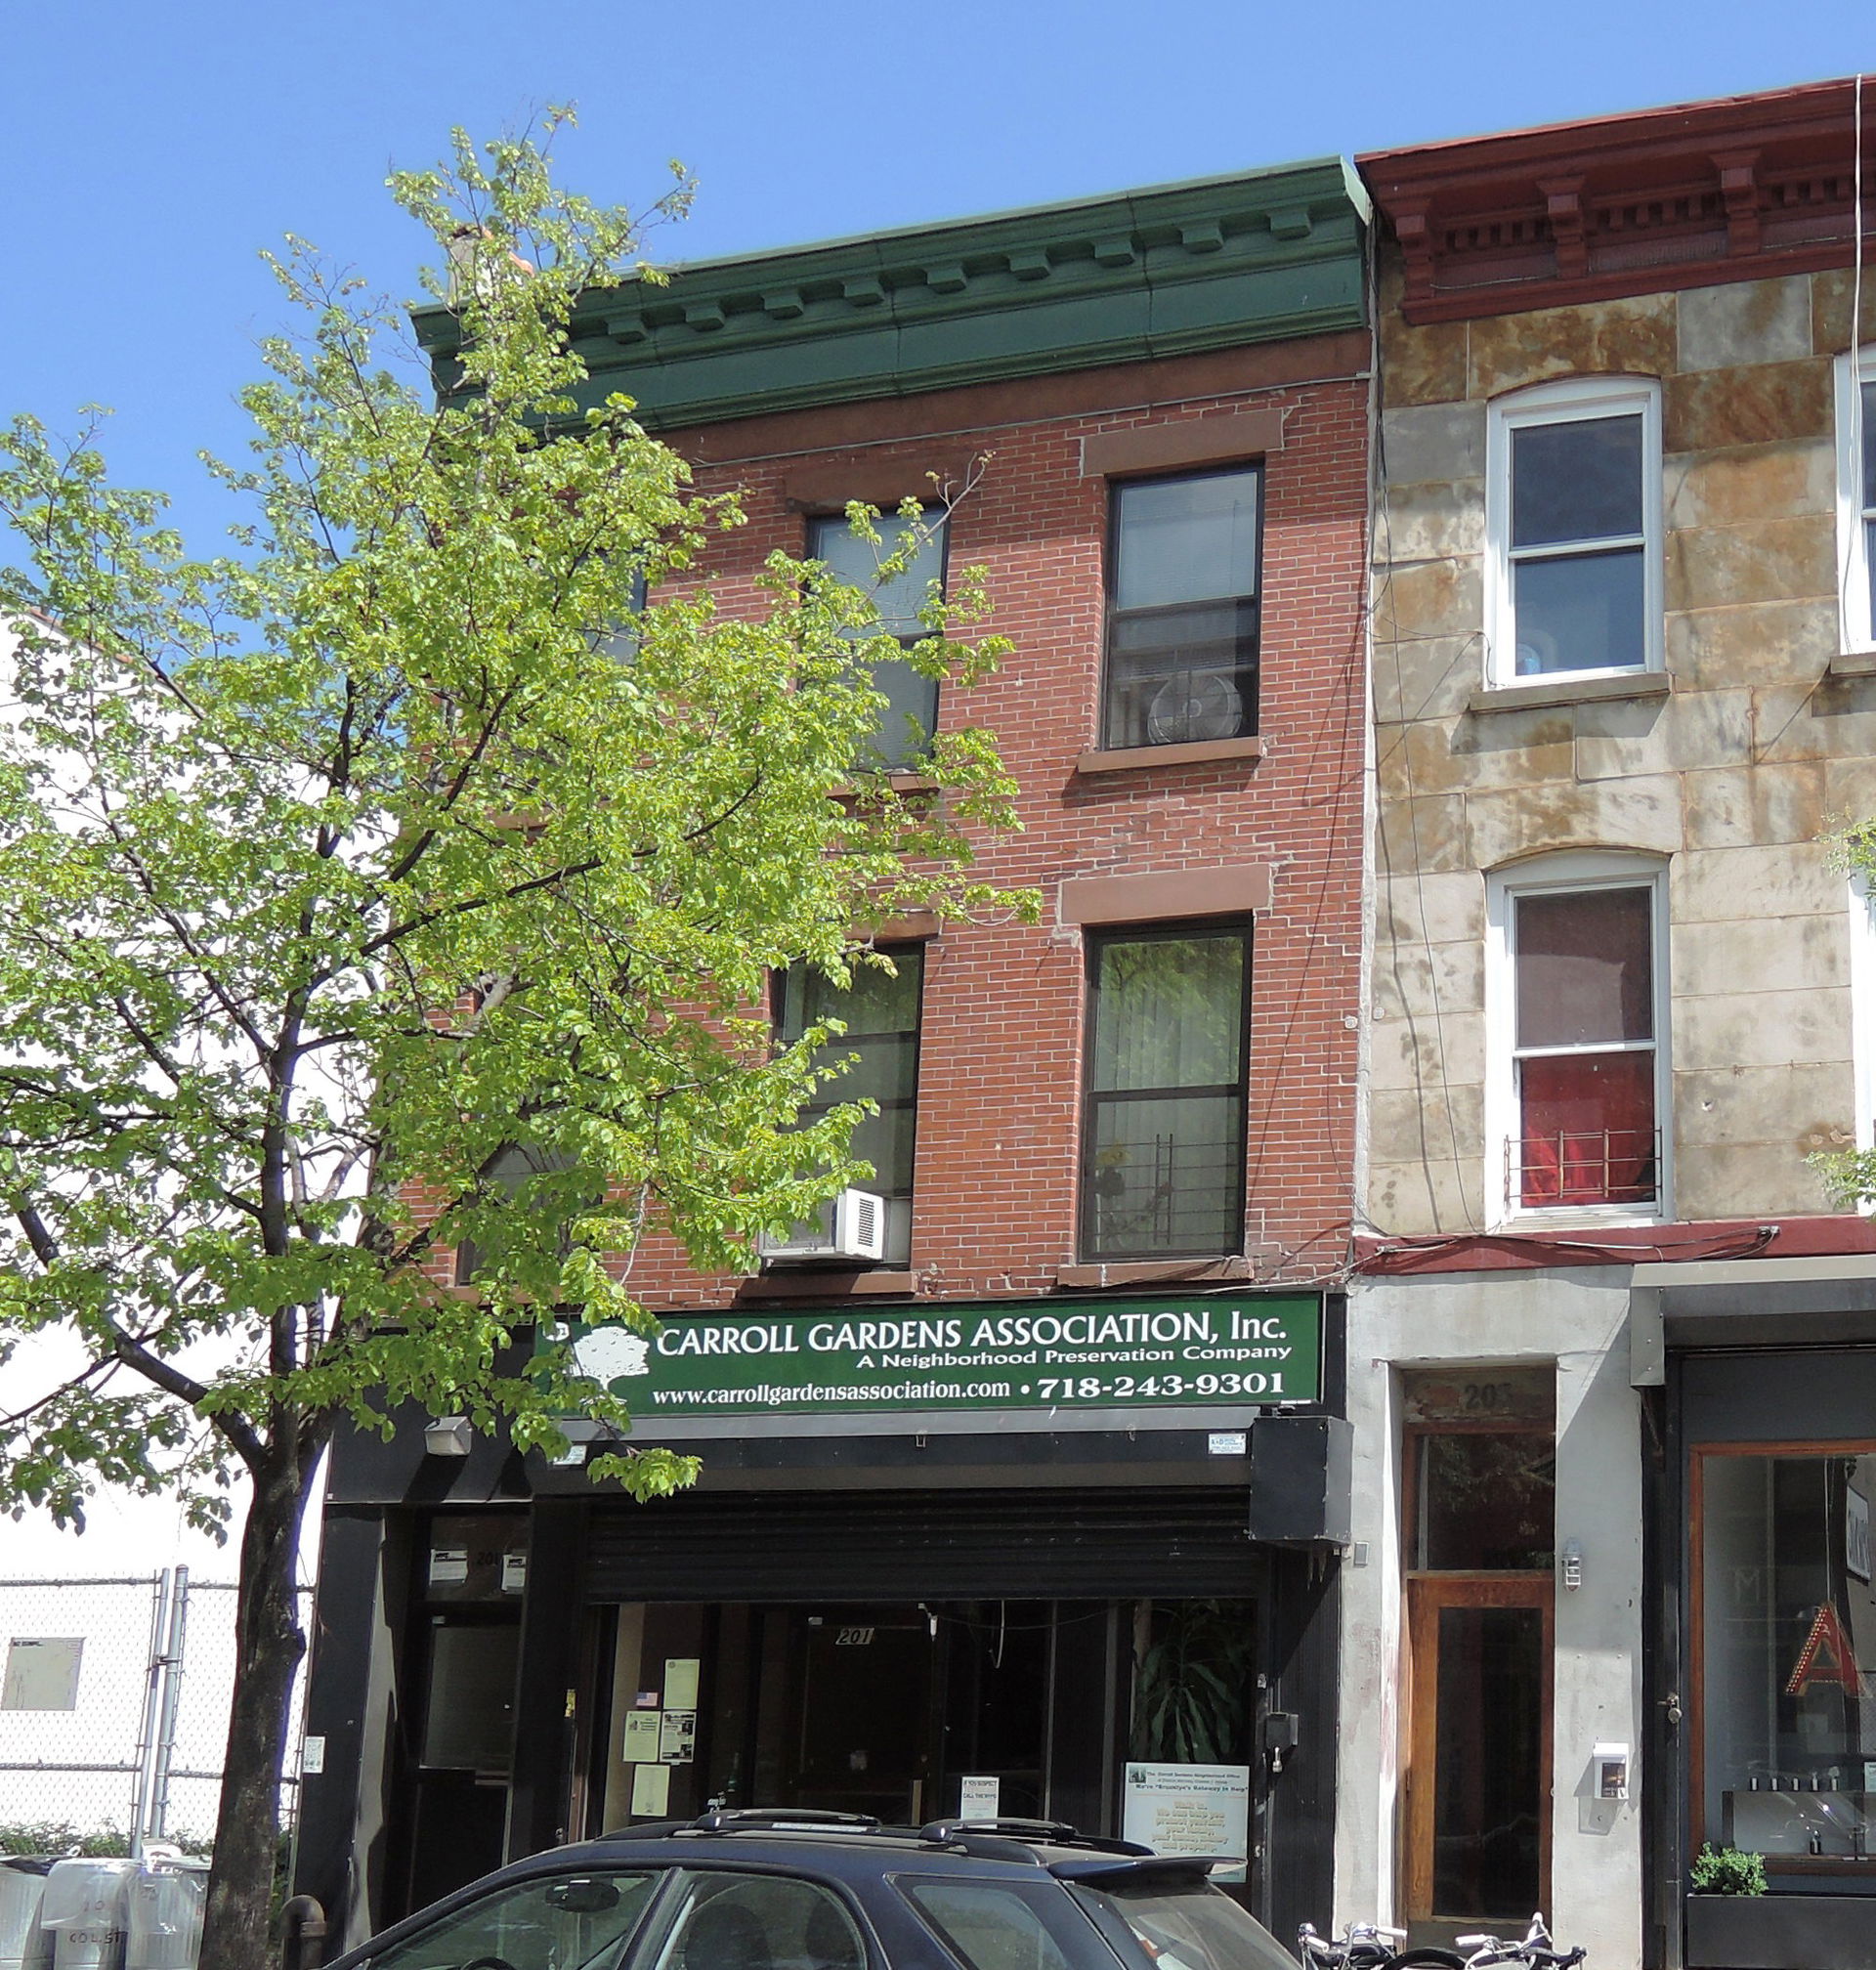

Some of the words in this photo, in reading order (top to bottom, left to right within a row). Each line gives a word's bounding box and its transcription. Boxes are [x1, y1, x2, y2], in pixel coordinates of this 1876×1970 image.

[656, 1323, 800, 1356] CARROLL
[807, 1319, 961, 1351] GARDENS
[969, 1311, 1219, 1348] ASSOCIATION,
[1230, 1310, 1287, 1341] Inc.
[855, 1354, 875, 1369] A
[881, 1349, 1038, 1370] Neighborhood
[1045, 1348, 1174, 1364] Preservation
[1182, 1346, 1293, 1362] Company
[652, 1379, 1011, 1406] www.carrollgardensassociation.com
[1037, 1372, 1284, 1399] 718-243-9301
[838, 1629, 871, 1644] 201
